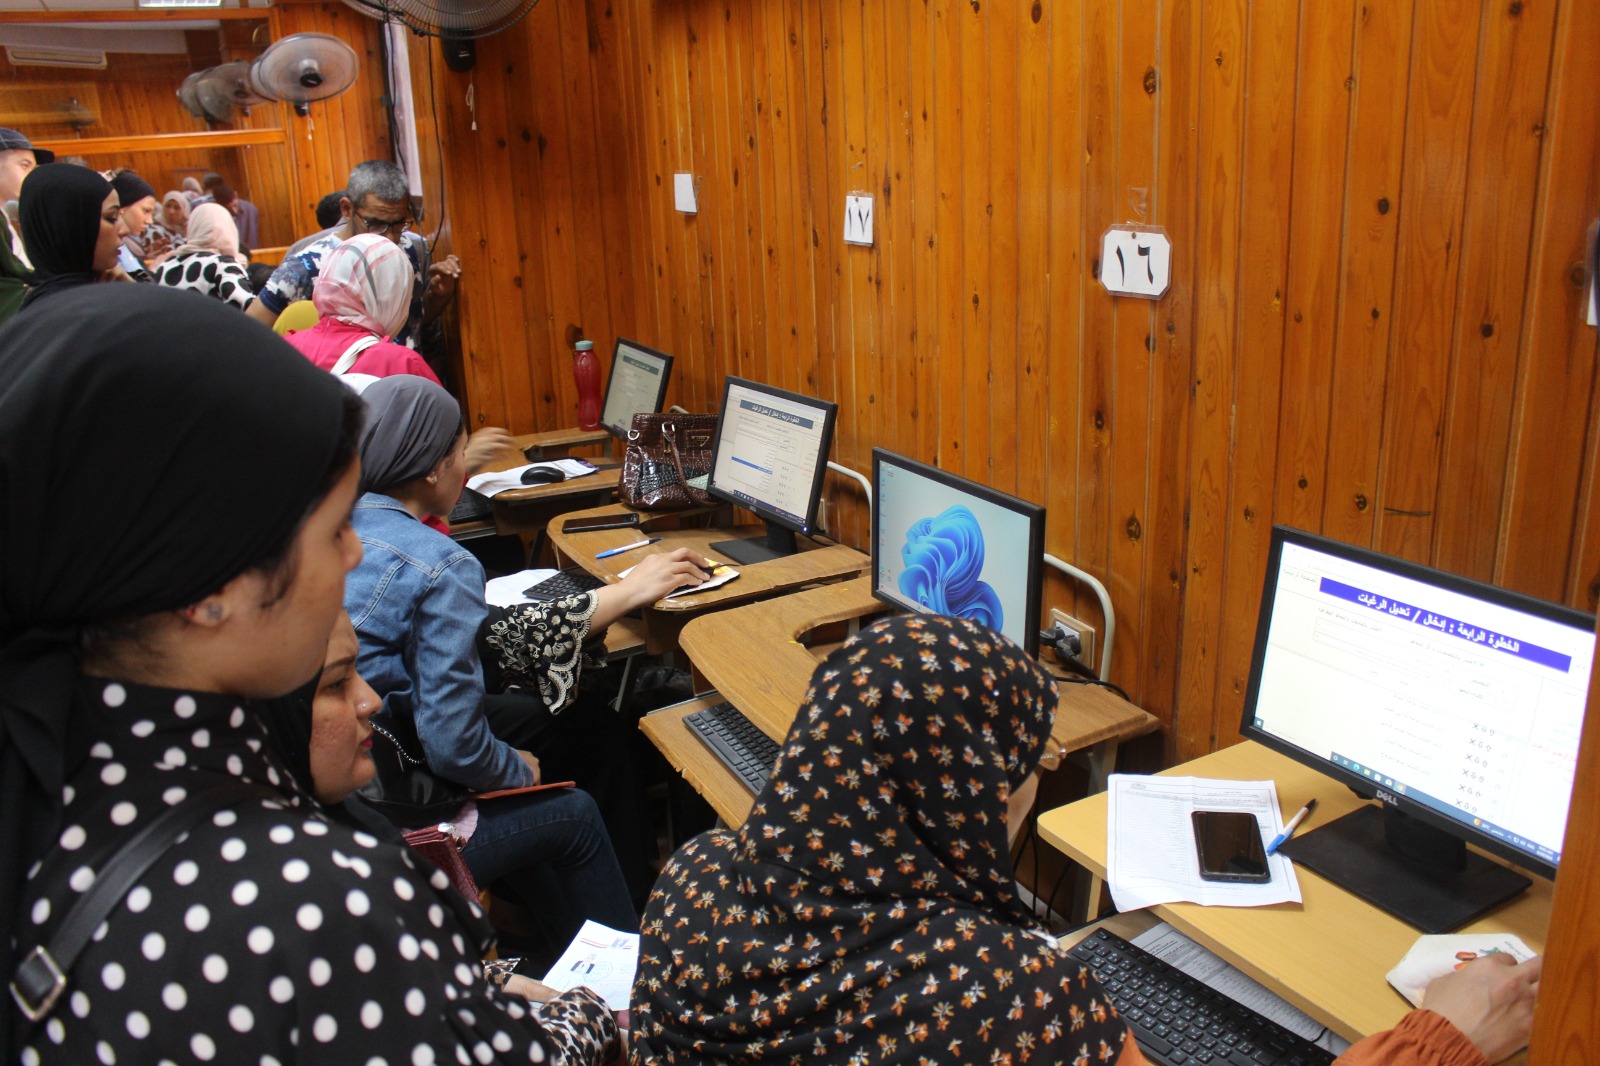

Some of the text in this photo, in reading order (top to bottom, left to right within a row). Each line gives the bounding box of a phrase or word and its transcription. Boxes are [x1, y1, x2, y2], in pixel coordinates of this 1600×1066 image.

[848, 207, 870, 237] ١٧
[1116, 243, 1154, 287] ١٦
[1357, 592, 1388, 610] الرغبات
[1457, 622, 1486, 642] الرابعة
[1487, 633, 1520, 653] الخطوة
[1376, 789, 1398, 806] DELL
